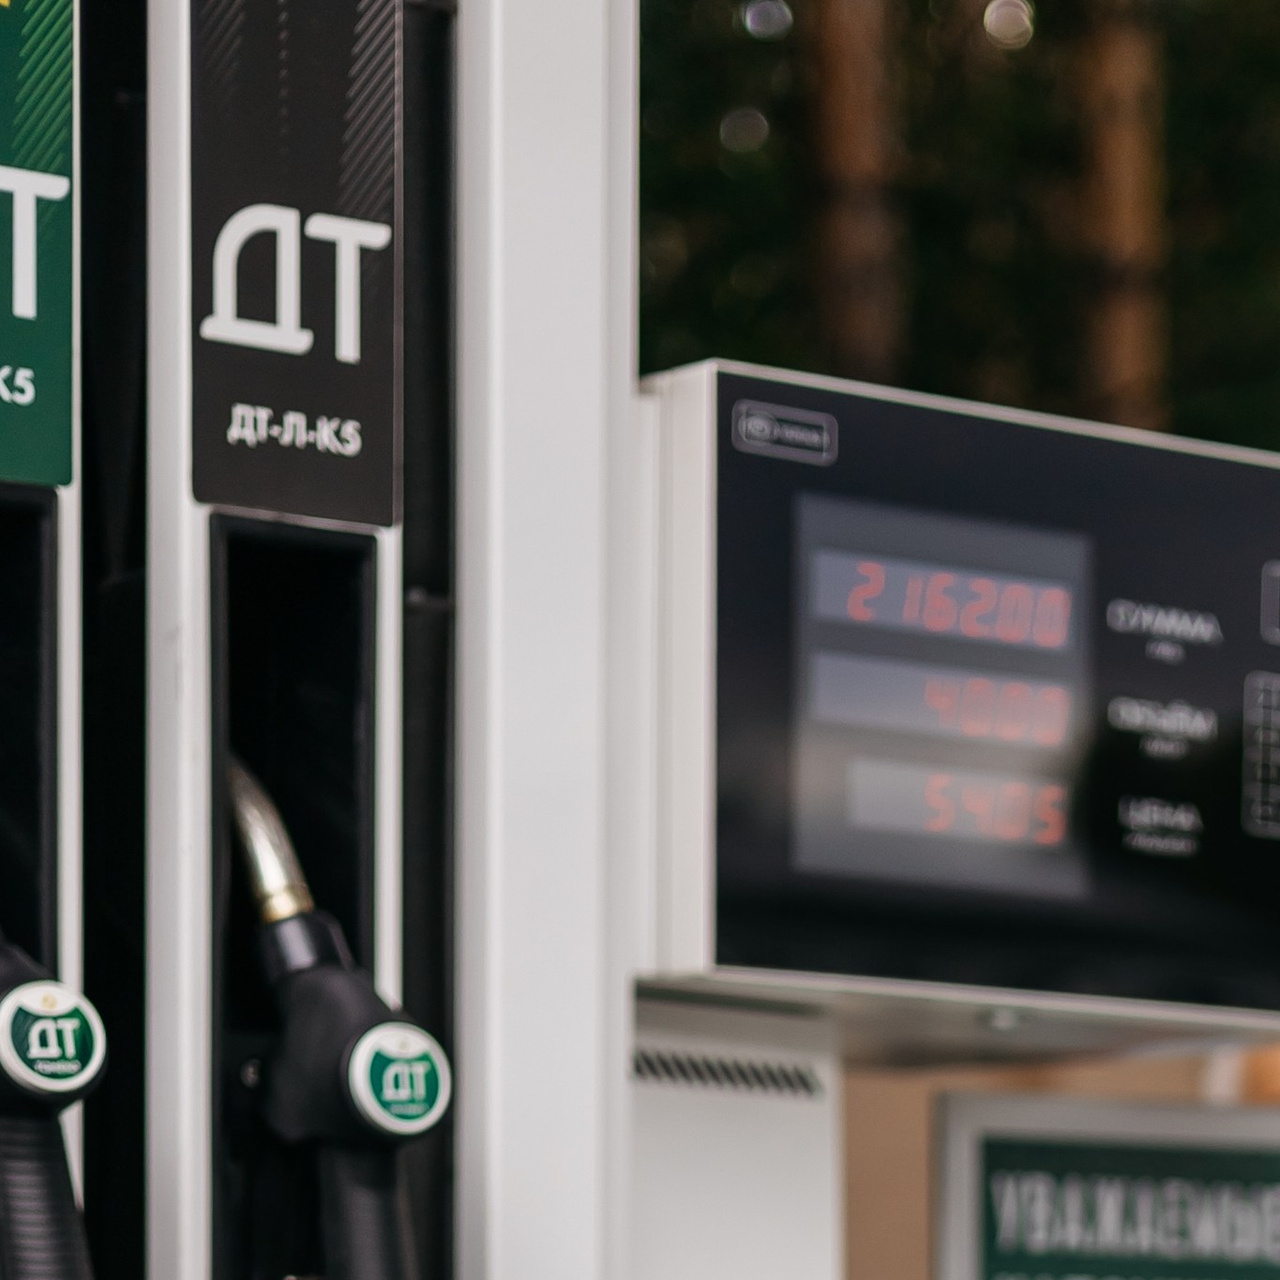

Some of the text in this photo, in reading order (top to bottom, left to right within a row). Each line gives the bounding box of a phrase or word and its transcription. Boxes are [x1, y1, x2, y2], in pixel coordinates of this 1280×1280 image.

[201, 204, 391, 362] ДТ
[227, 403, 362, 457] ДТ-Л-К5
[27, 1018, 80, 1059] ДТ
[381, 1061, 431, 1101] ДТ
